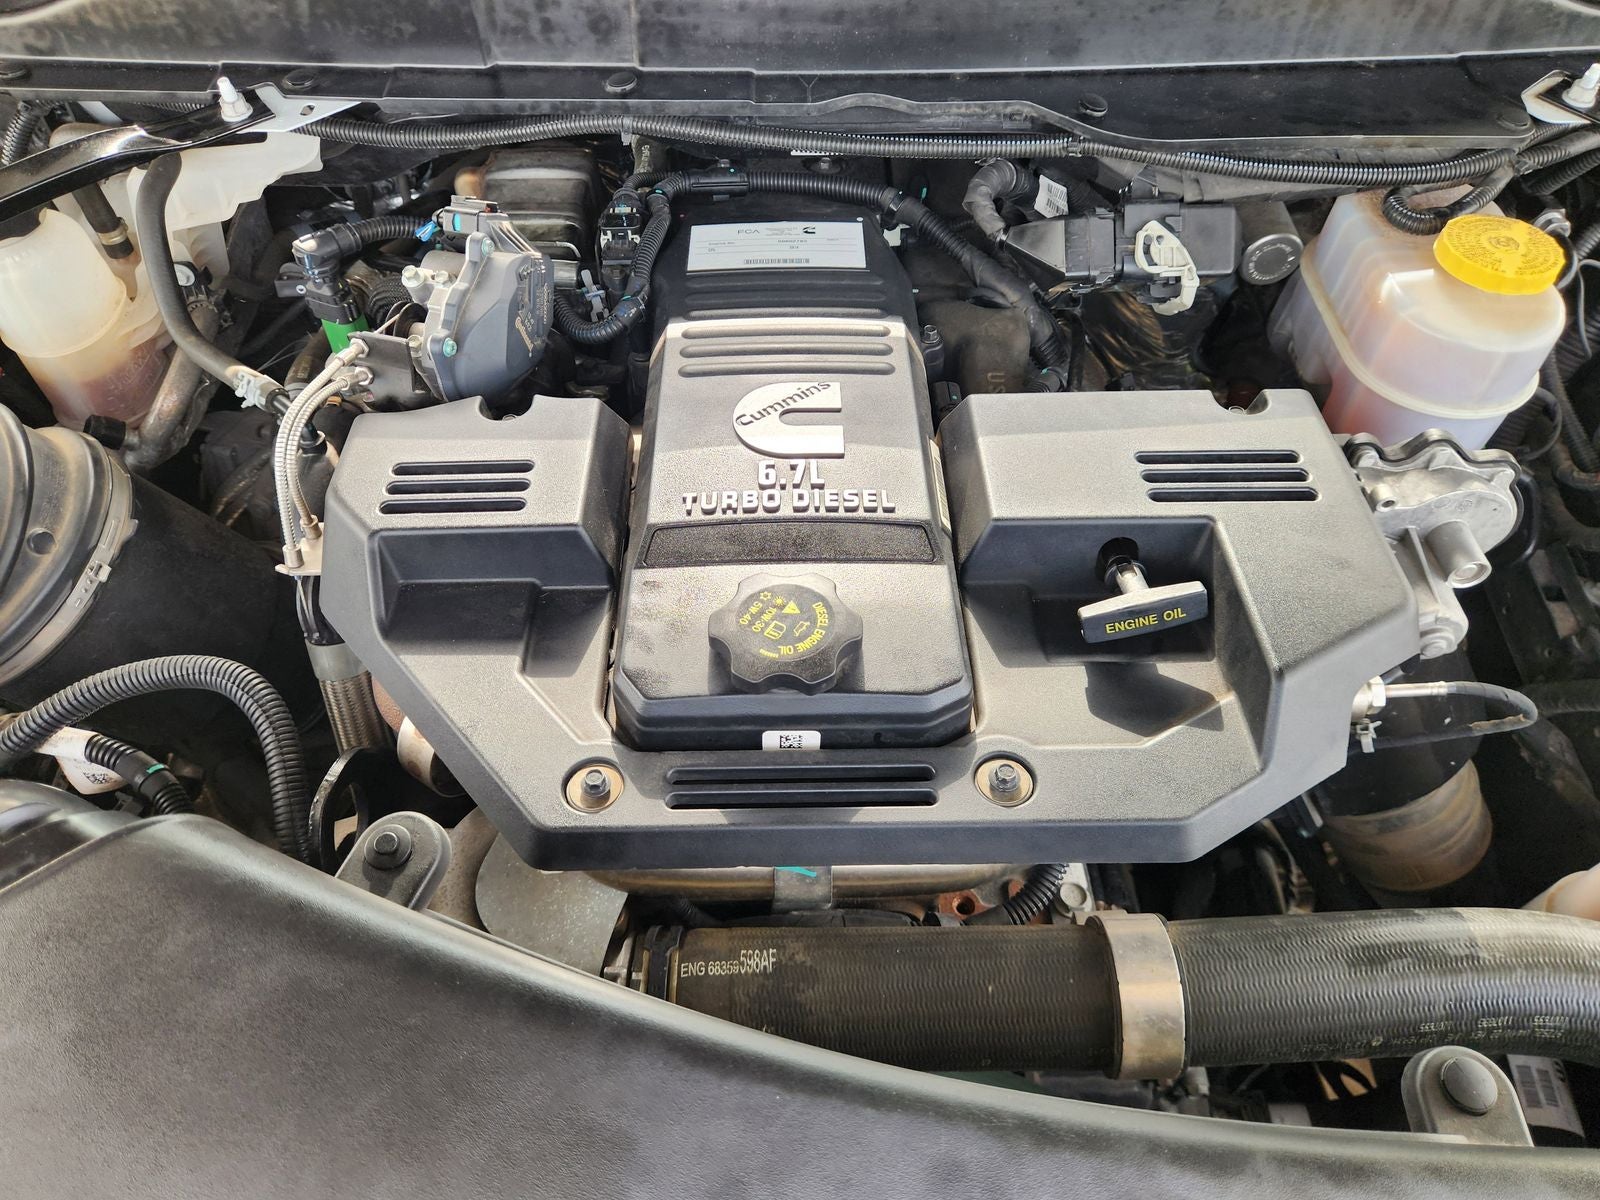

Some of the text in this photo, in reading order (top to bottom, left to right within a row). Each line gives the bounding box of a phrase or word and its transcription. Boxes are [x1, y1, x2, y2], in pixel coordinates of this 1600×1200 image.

[735, 381, 832, 426] Cummins
[758, 459, 825, 490] 6.7L
[682, 489, 896, 516] TURBO DIESEL
[739, 601, 763, 625] 5W-40
[751, 606, 777, 633] 10W-30
[1105, 607, 1187, 634] ENGINE OIL
[778, 601, 829, 655] DIESEL ENGINE OIL
[680, 961, 706, 978] ENG
